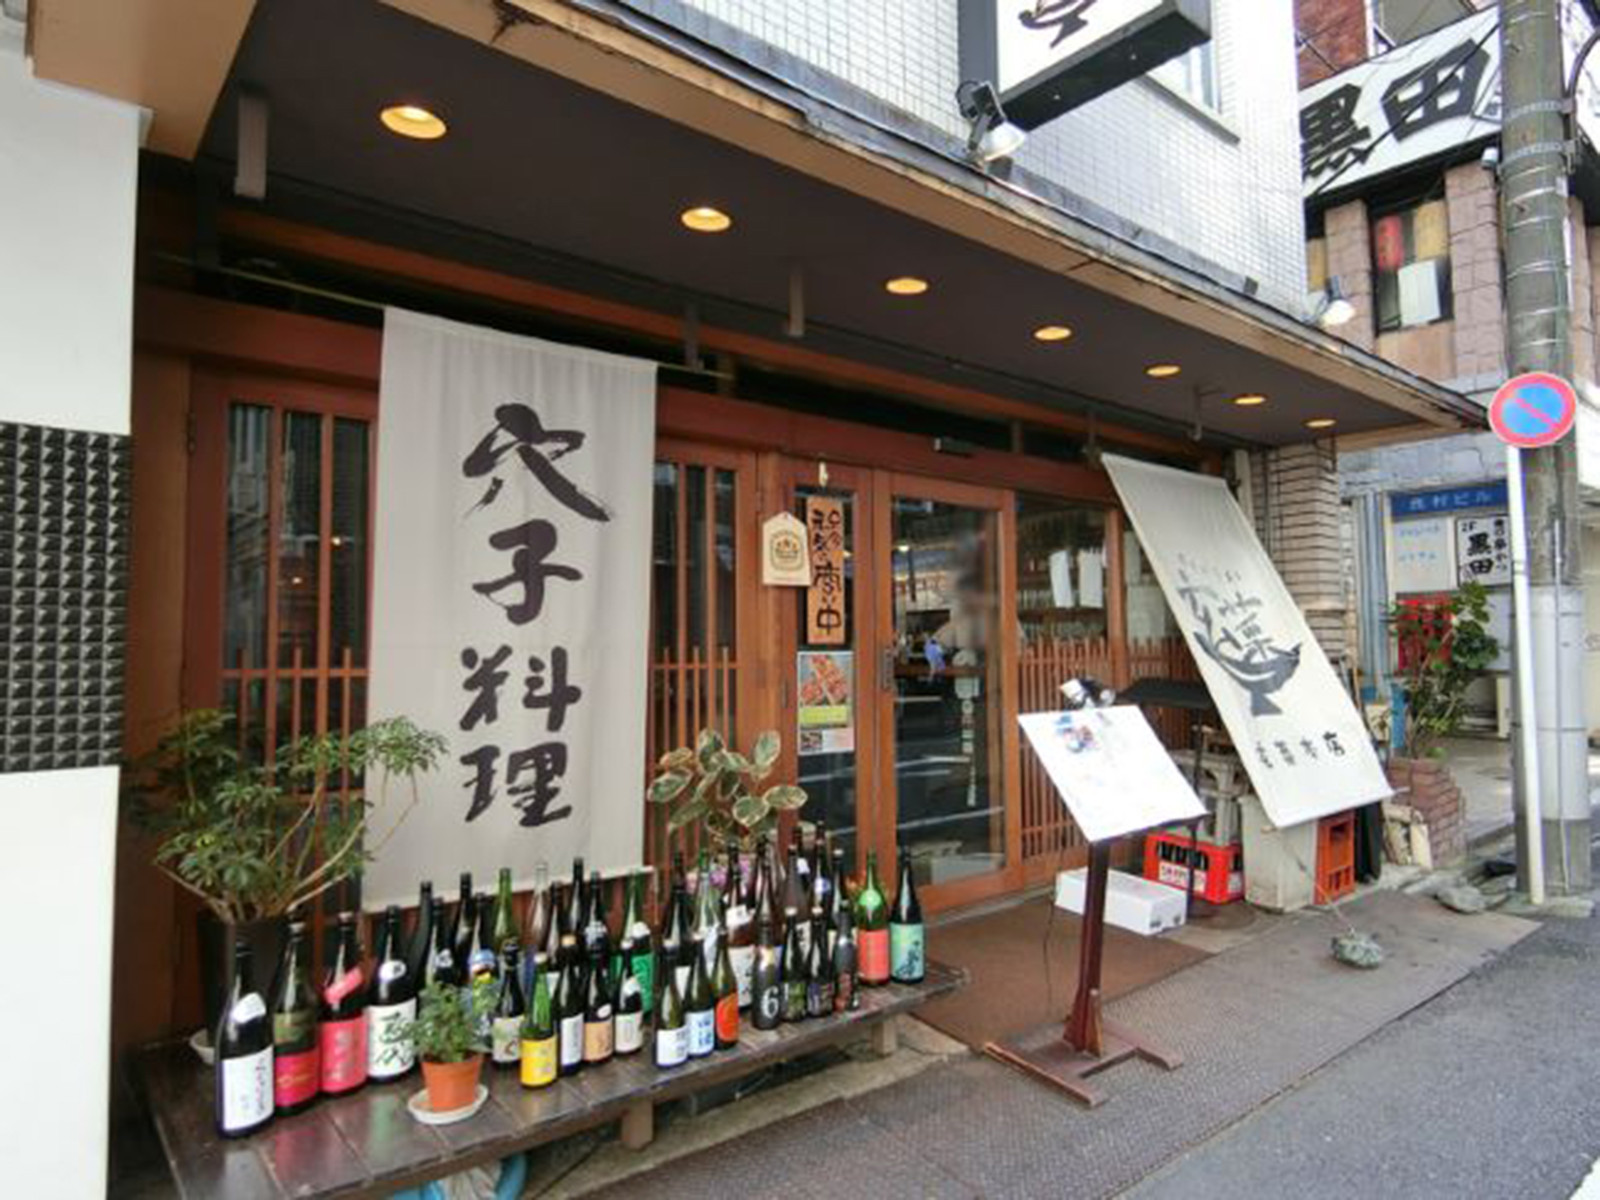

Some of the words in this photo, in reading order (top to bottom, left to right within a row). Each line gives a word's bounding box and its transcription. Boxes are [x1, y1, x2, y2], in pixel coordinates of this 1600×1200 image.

[1300, 38, 1490, 178] 黒田
[460, 403, 611, 827] 穴子料理
[1467, 532, 1494, 575] 黒田
